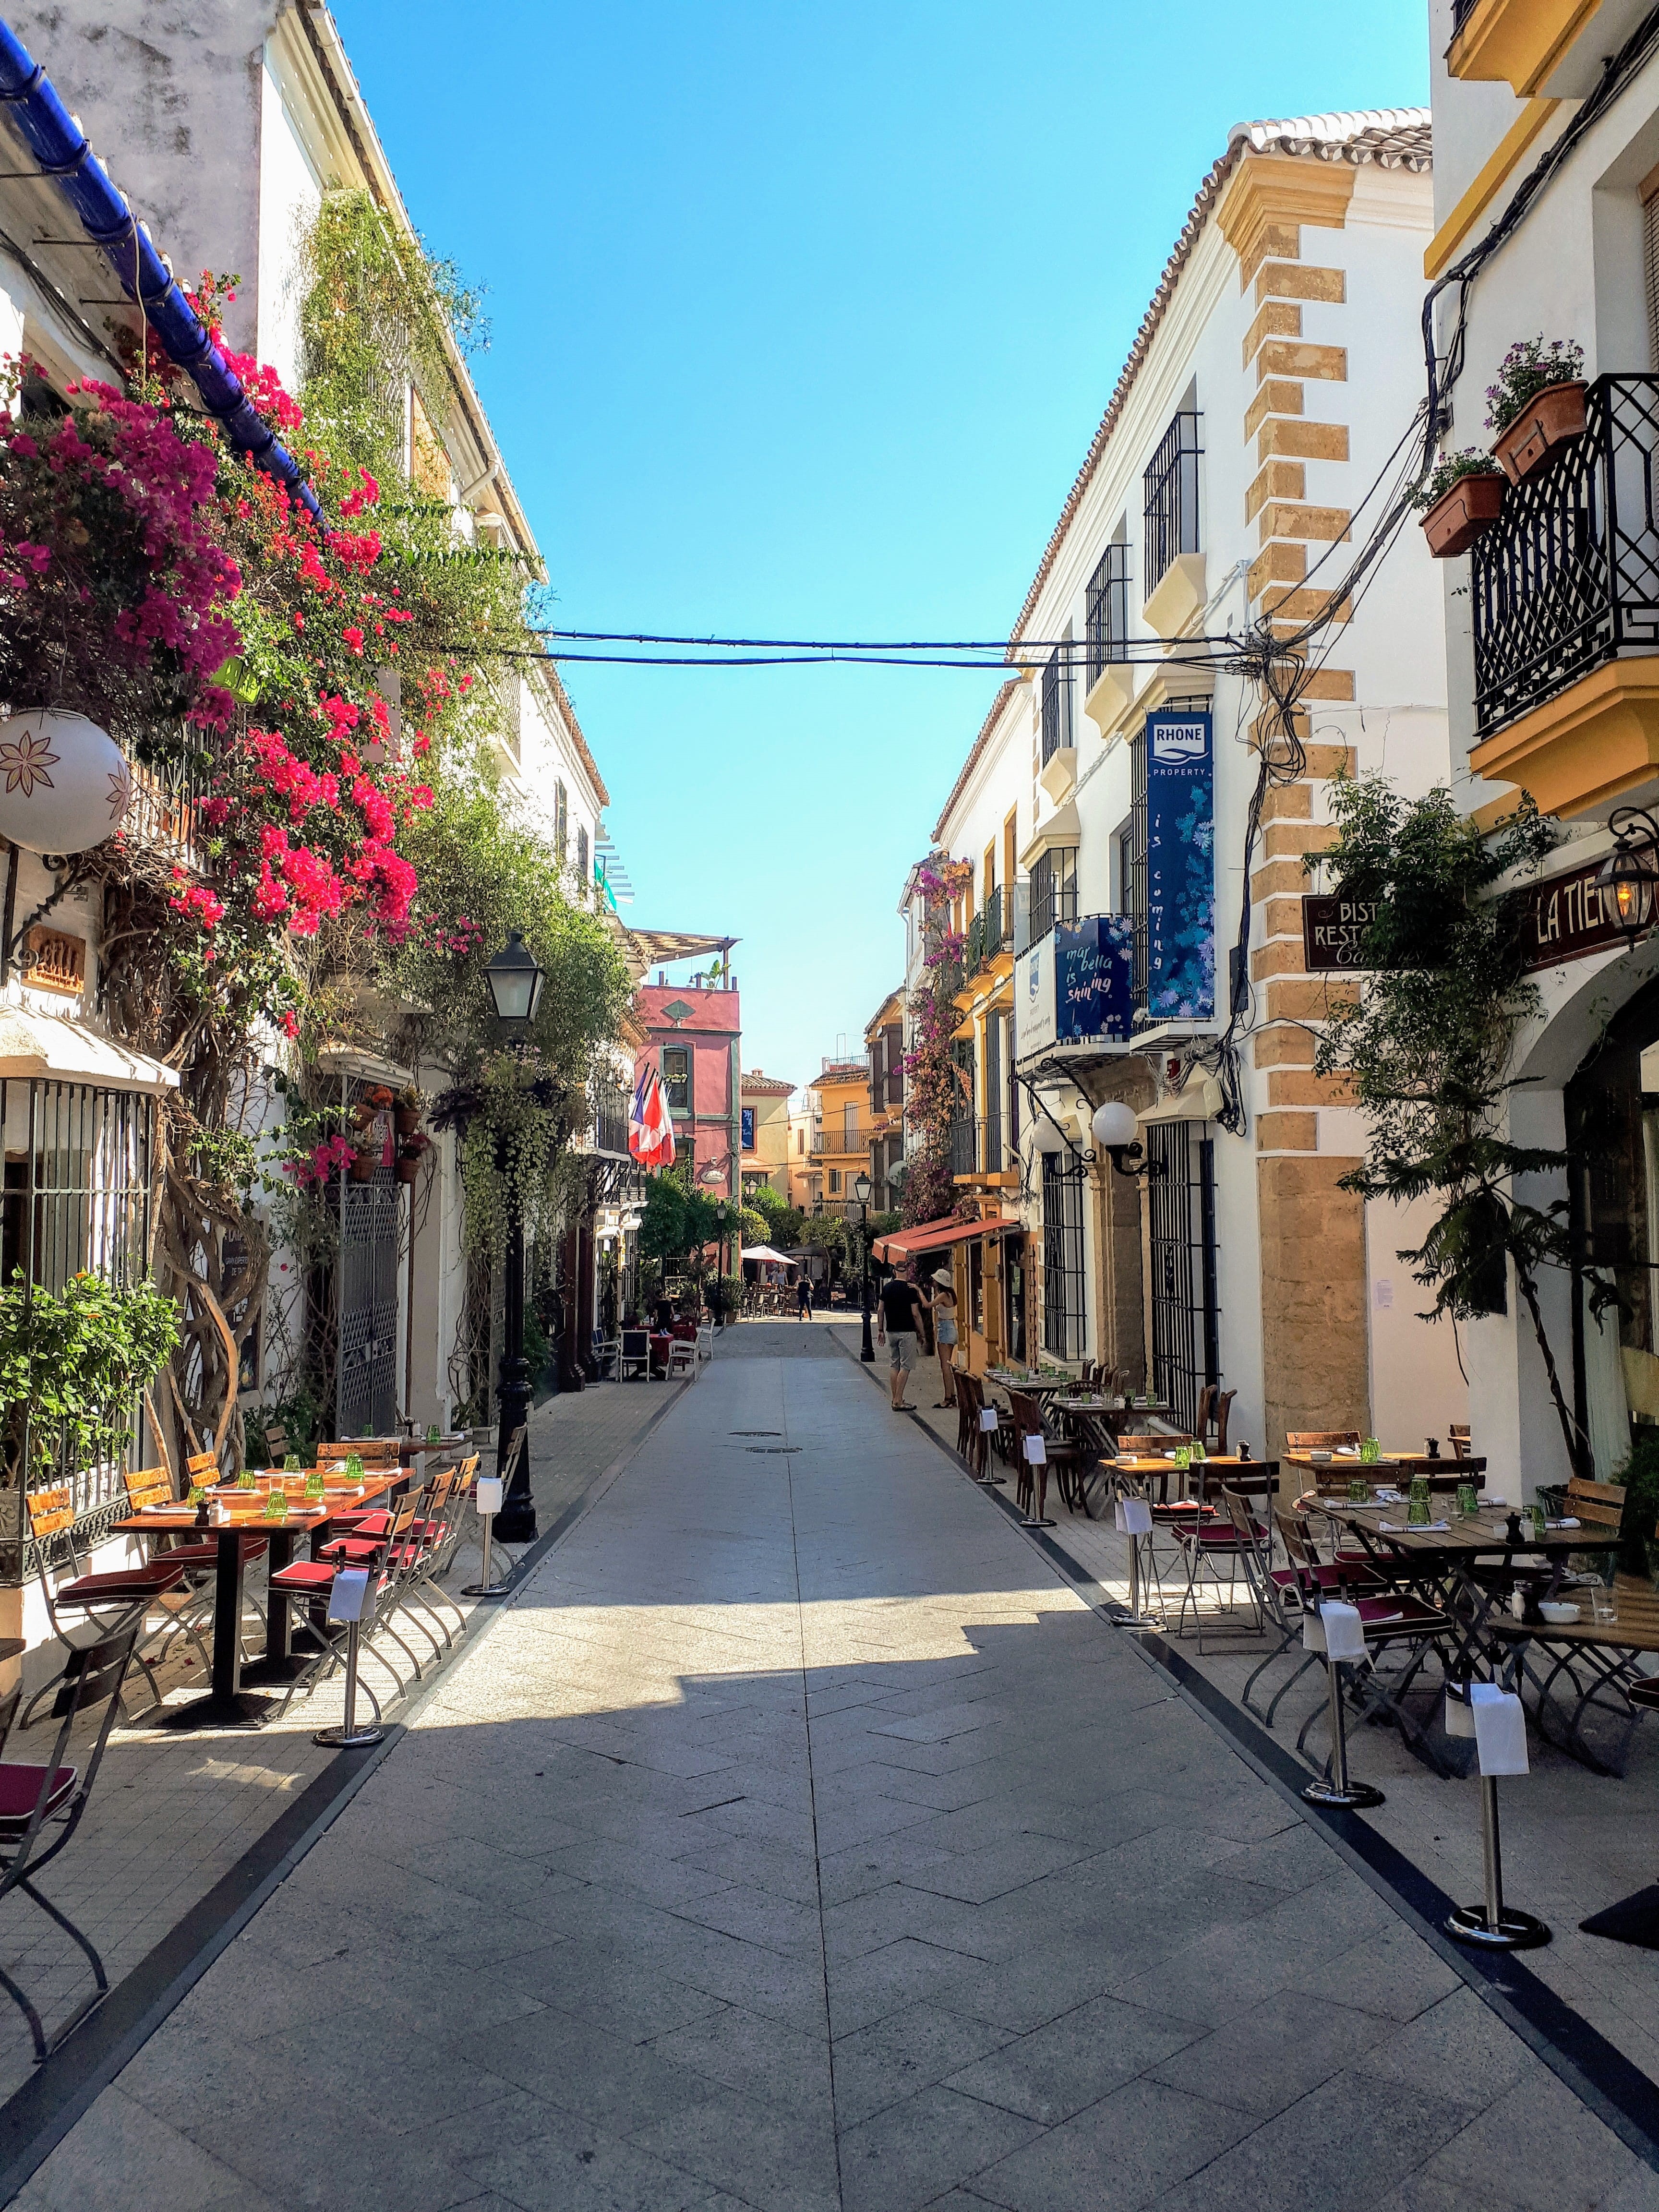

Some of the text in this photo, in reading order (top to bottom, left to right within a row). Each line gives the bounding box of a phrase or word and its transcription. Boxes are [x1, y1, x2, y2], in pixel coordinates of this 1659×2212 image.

[1152, 814, 1164, 970] is coming
[1340, 902, 1379, 922] BIST
[1537, 890, 1560, 944] LA
[1315, 925, 1361, 946] REST
